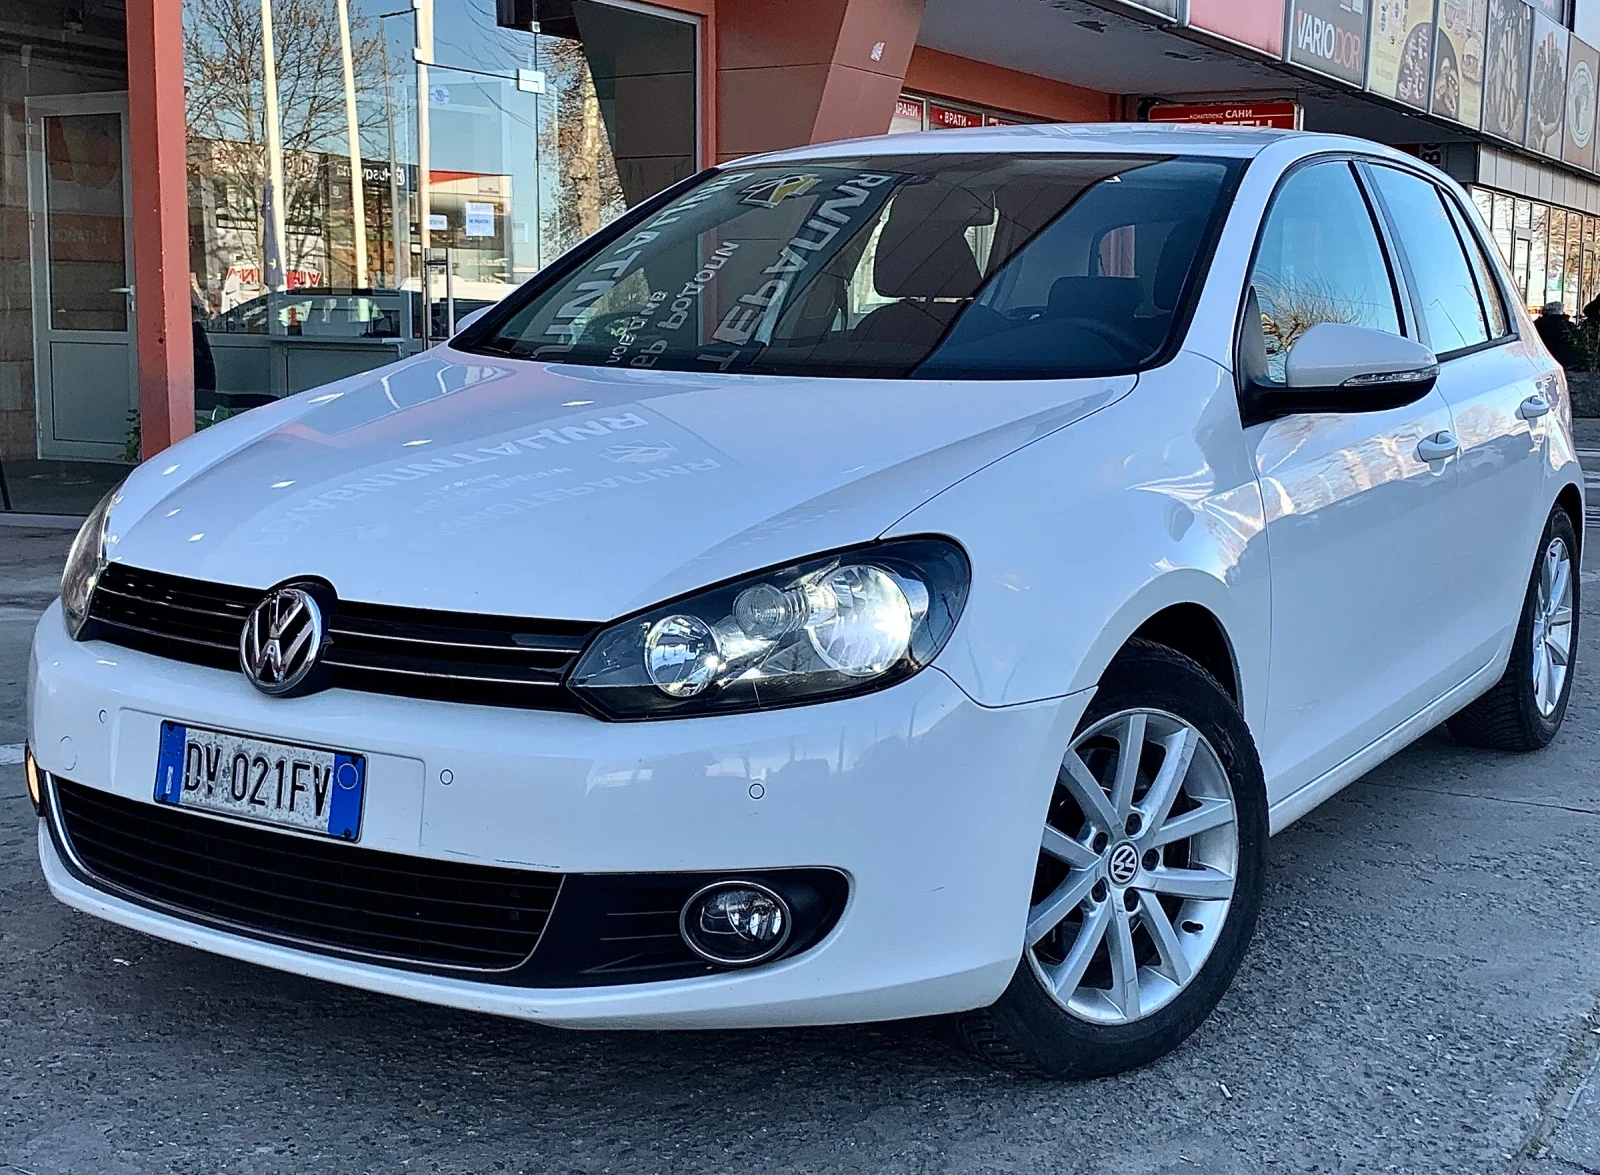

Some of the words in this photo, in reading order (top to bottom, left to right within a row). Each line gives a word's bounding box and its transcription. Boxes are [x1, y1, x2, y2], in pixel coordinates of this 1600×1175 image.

[1297, 10, 1361, 71] VARIODOR
[944, 111, 967, 127] ВРАТИ
[1225, 109, 1253, 119] САНИ
[184, 743, 222, 794] DV
[231, 752, 333, 816] 021FV
